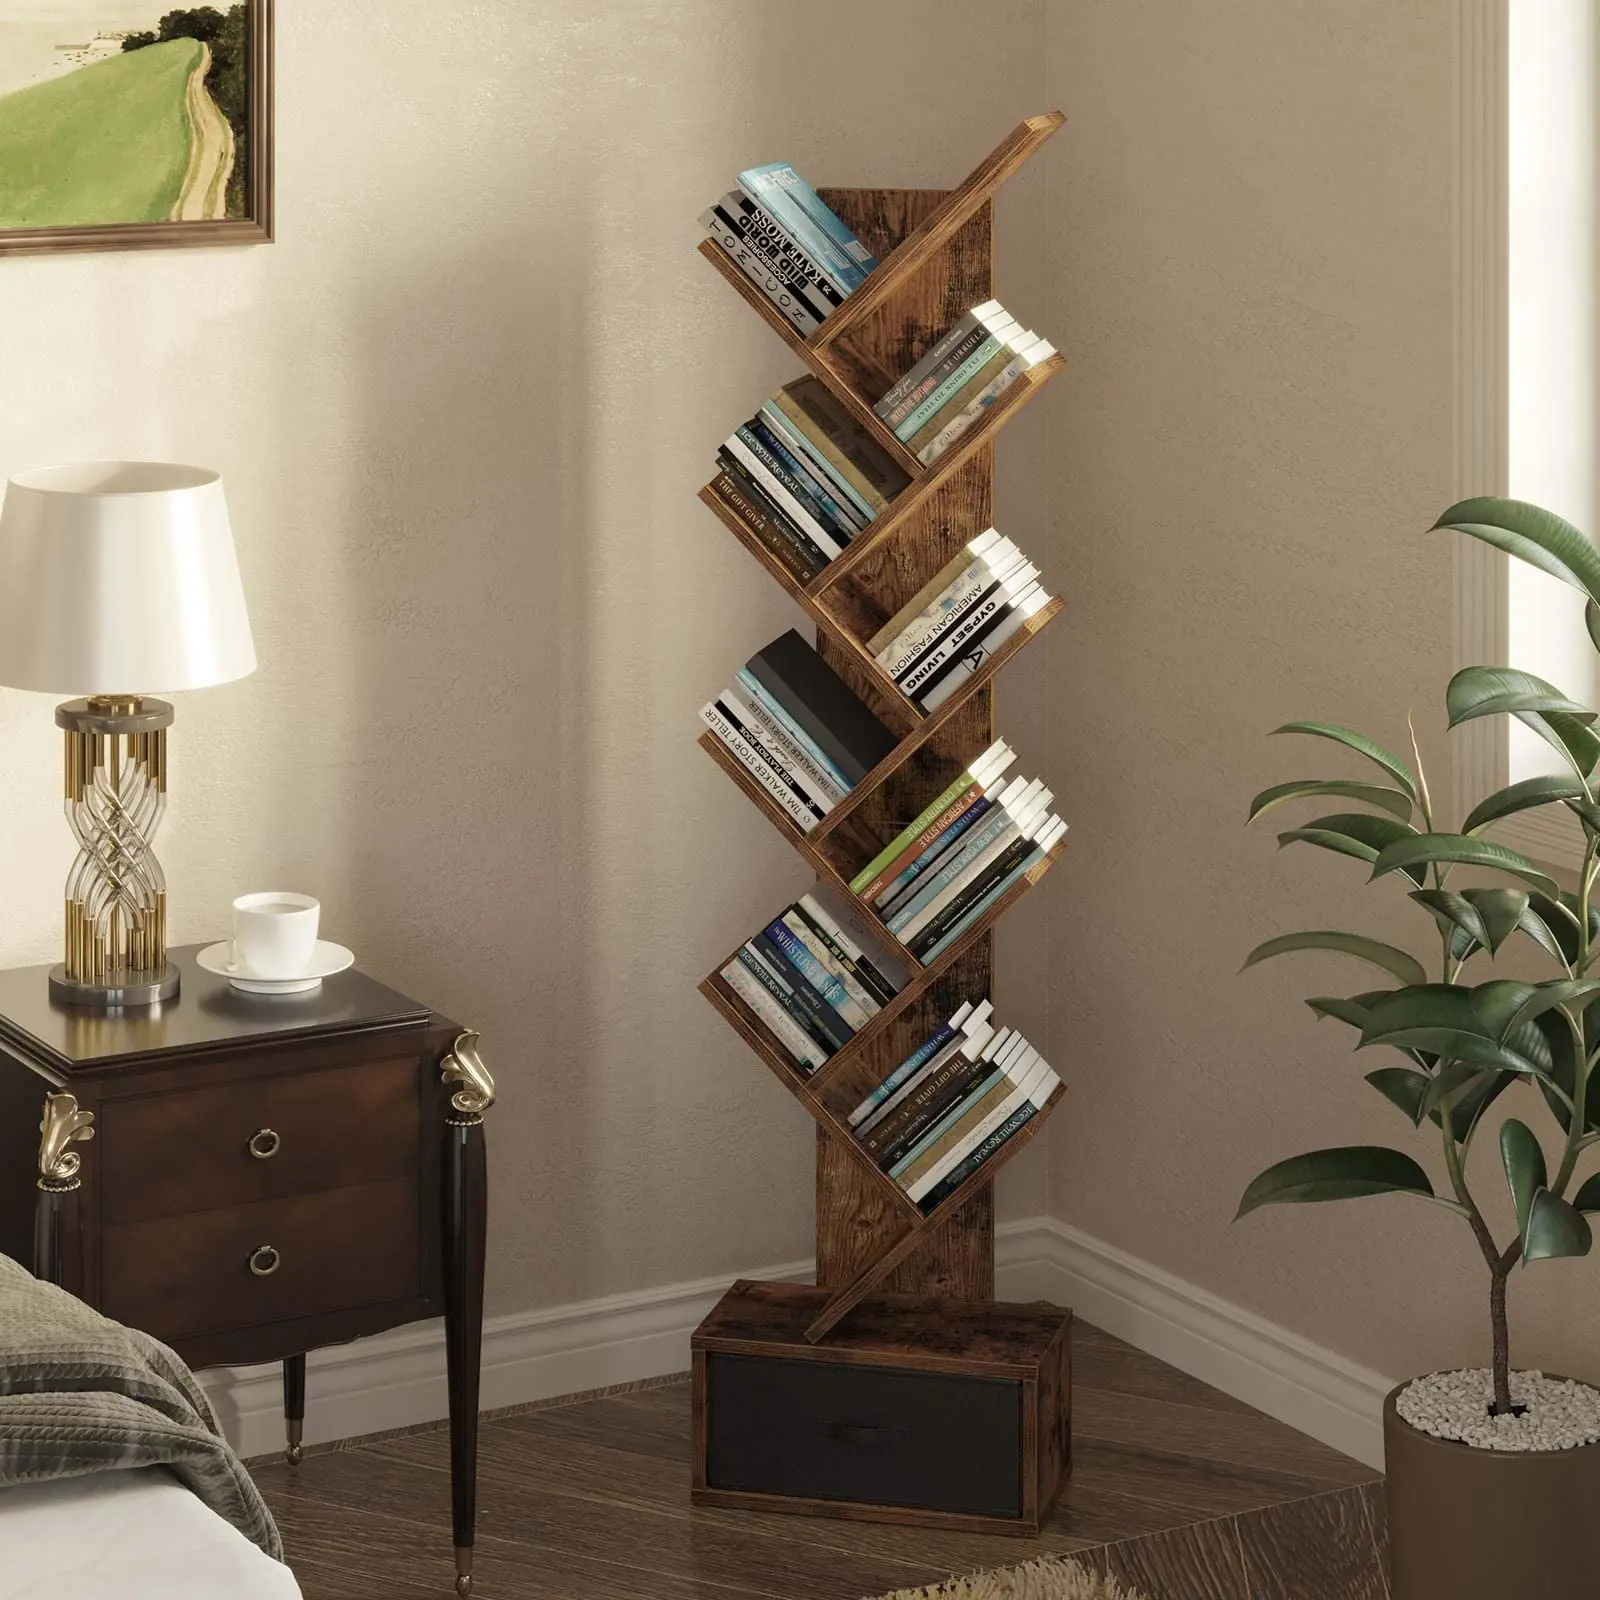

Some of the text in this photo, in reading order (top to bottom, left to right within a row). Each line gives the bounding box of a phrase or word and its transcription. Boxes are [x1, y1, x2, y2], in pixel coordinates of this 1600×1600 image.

[736, 213, 781, 259] WORLD
[750, 207, 789, 248] MOSS
[741, 234, 790, 286] ACCESSORIES
[777, 256, 809, 289] WILD
[785, 245, 824, 285] KATE
[934, 390, 945, 402] TO
[944, 368, 967, 392] DRINK
[717, 479, 733, 495] THE
[730, 492, 748, 511] GIFT
[744, 508, 765, 530] GIVER
[931, 583, 983, 634] AMERICAN
[948, 600, 996, 647] GYPSET
[889, 633, 932, 676] FASHION
[904, 650, 945, 690] LIVING
[963, 647, 983, 670] A
[703, 708, 802, 814] TIM WALKER STORY TELLER
[738, 725, 794, 785] THE PLAYBOY BOOK
[746, 700, 830, 790] TIM WALKER STORY TELLER
[917, 800, 965, 847] AFRICAN STYLE
[940, 861, 961, 883] STYLE
[958, 845, 977, 864] YORK
[774, 931, 817, 977] WHISTLING
[932, 1070, 950, 1088] GIFT
[947, 1058, 963, 1074] THE
[914, 1084, 935, 1105] GIVER
